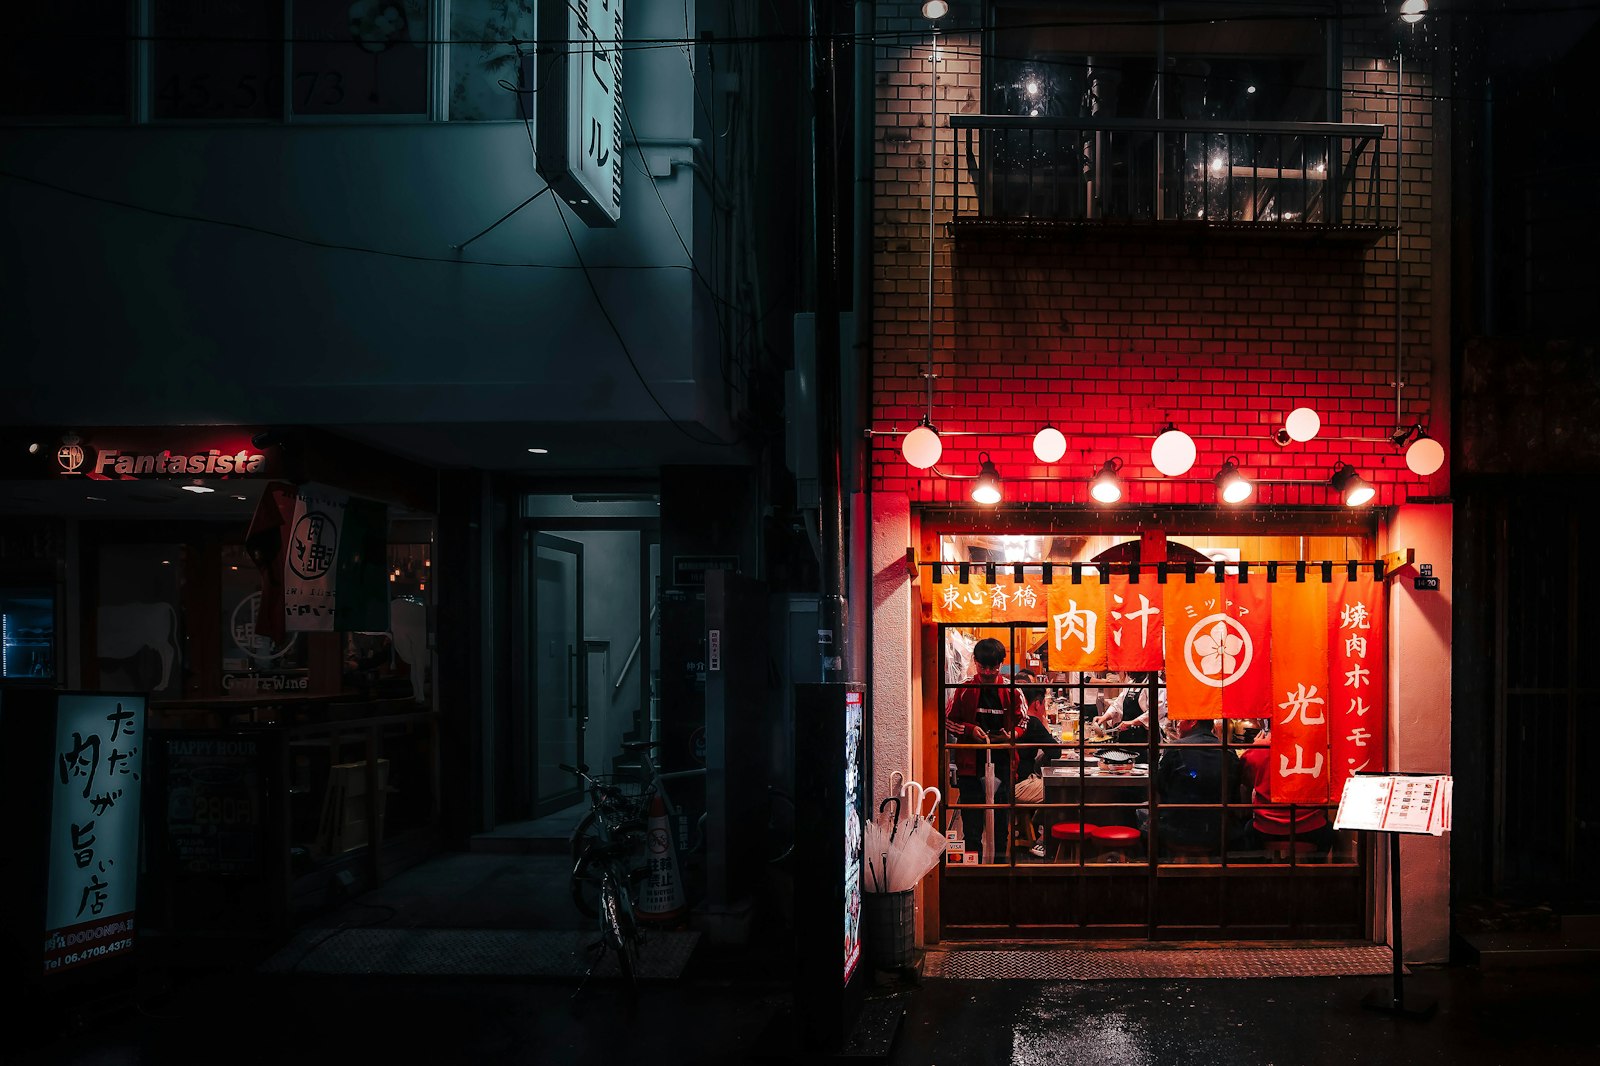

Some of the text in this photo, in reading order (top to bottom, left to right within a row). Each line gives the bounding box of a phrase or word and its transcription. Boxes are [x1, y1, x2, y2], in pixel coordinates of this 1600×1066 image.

[94, 449, 267, 474] Fantasista
[940, 583, 1038, 612] 東心斎橋
[1052, 593, 1161, 655] 肉汁
[1278, 682, 1326, 779] 光山
[168, 740, 258, 757] HAPPY HOUR
[43, 938, 133, 971] Tel 06.4708.4375
